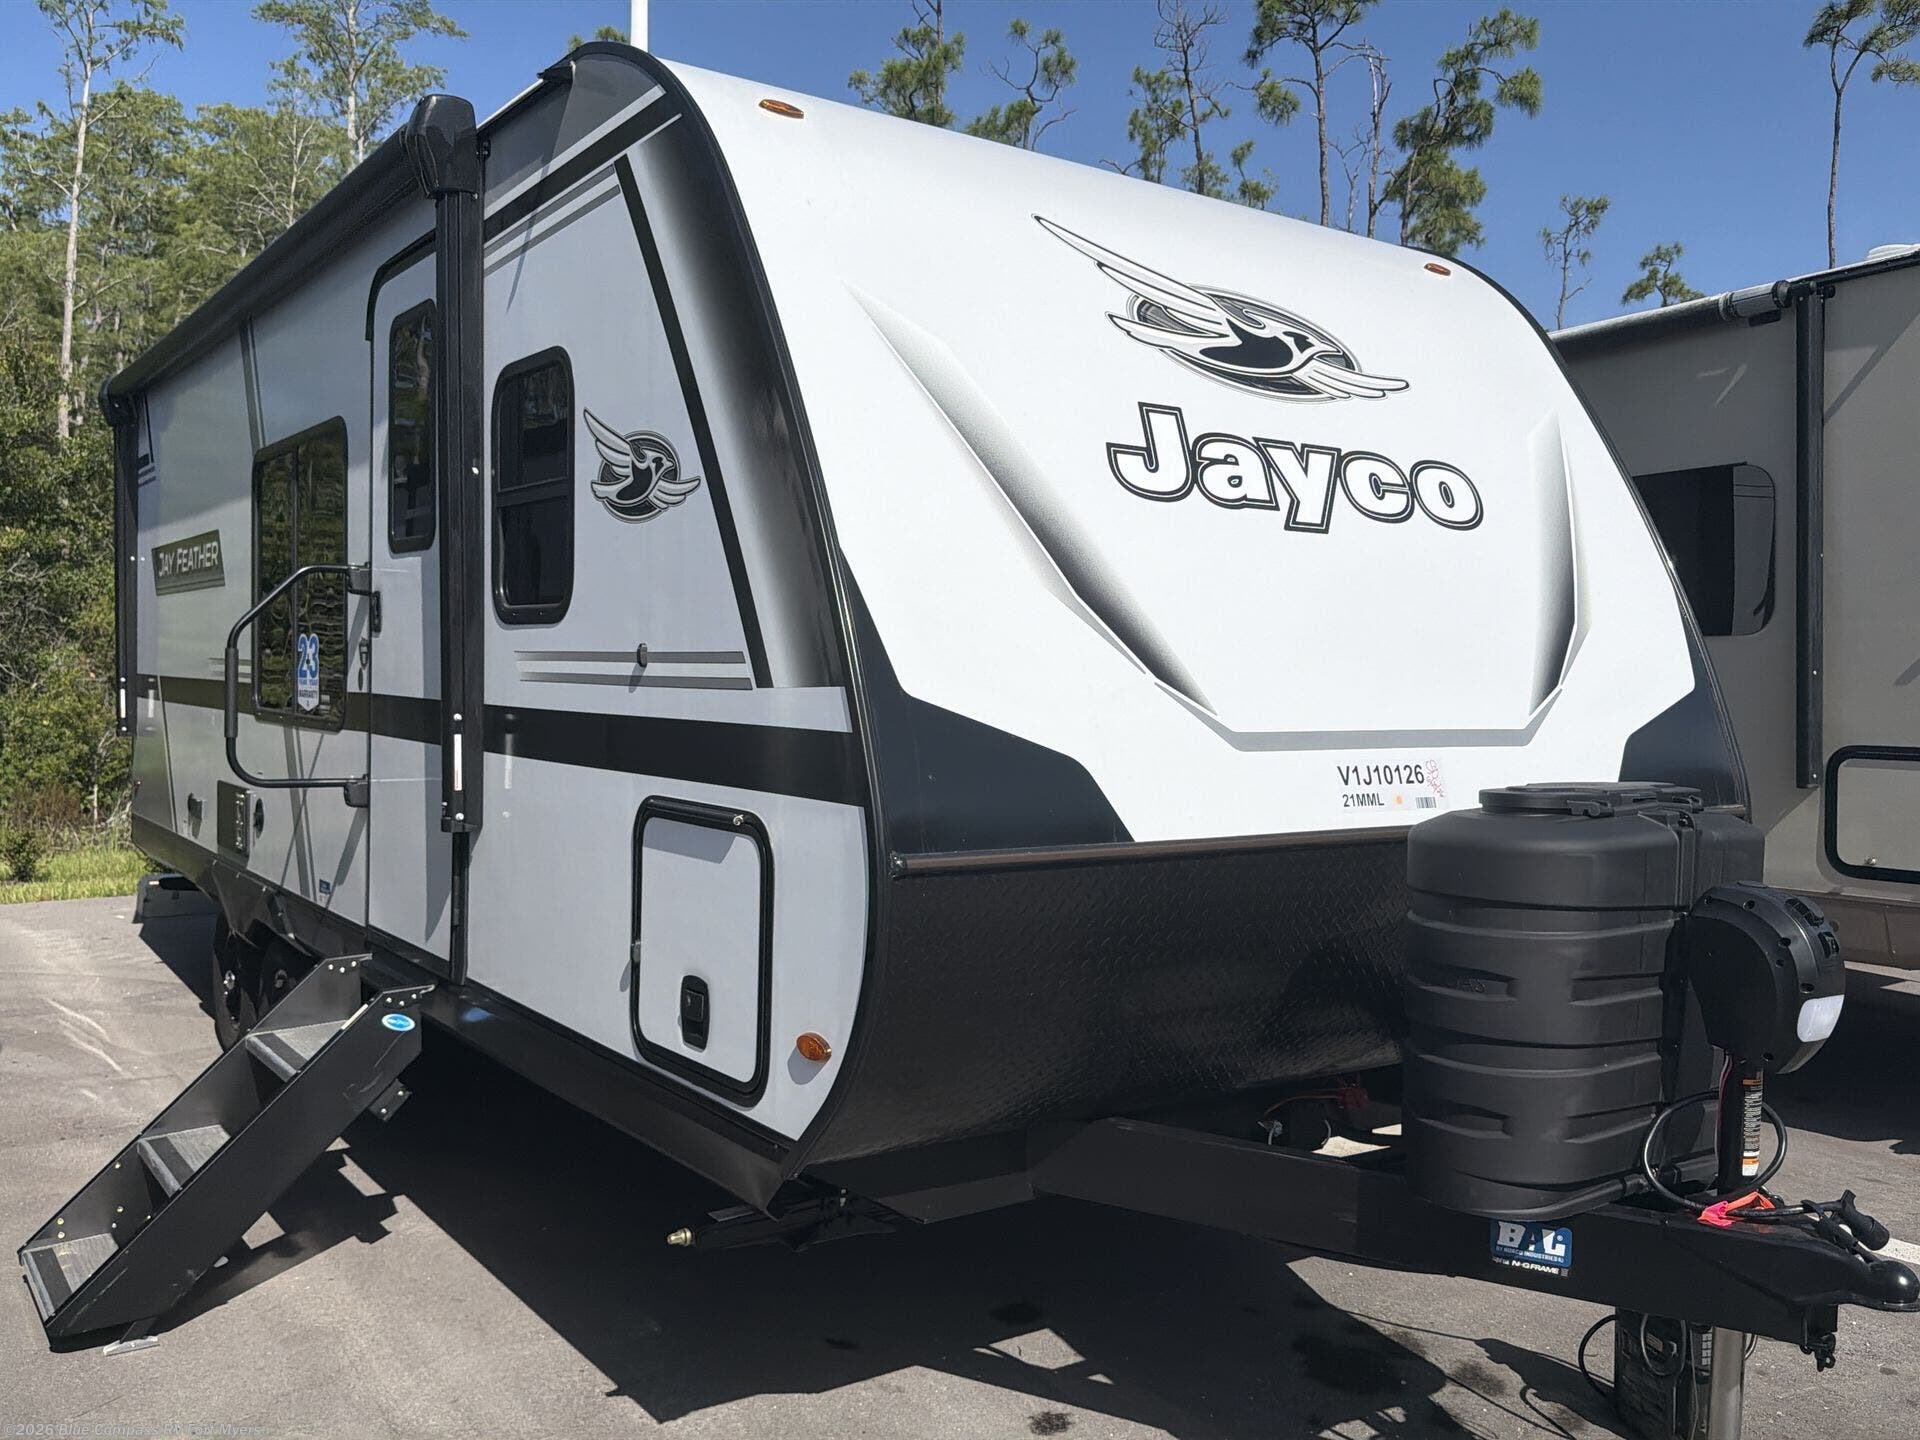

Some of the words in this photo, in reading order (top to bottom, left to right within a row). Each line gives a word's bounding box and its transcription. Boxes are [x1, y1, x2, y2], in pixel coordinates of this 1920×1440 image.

[1106, 401, 1484, 534] Jayco
[158, 552, 175, 577] JAY
[176, 540, 219, 574] FEATHER
[1337, 764, 1425, 786] V1J10126
[1342, 793, 1385, 808] 21MML
